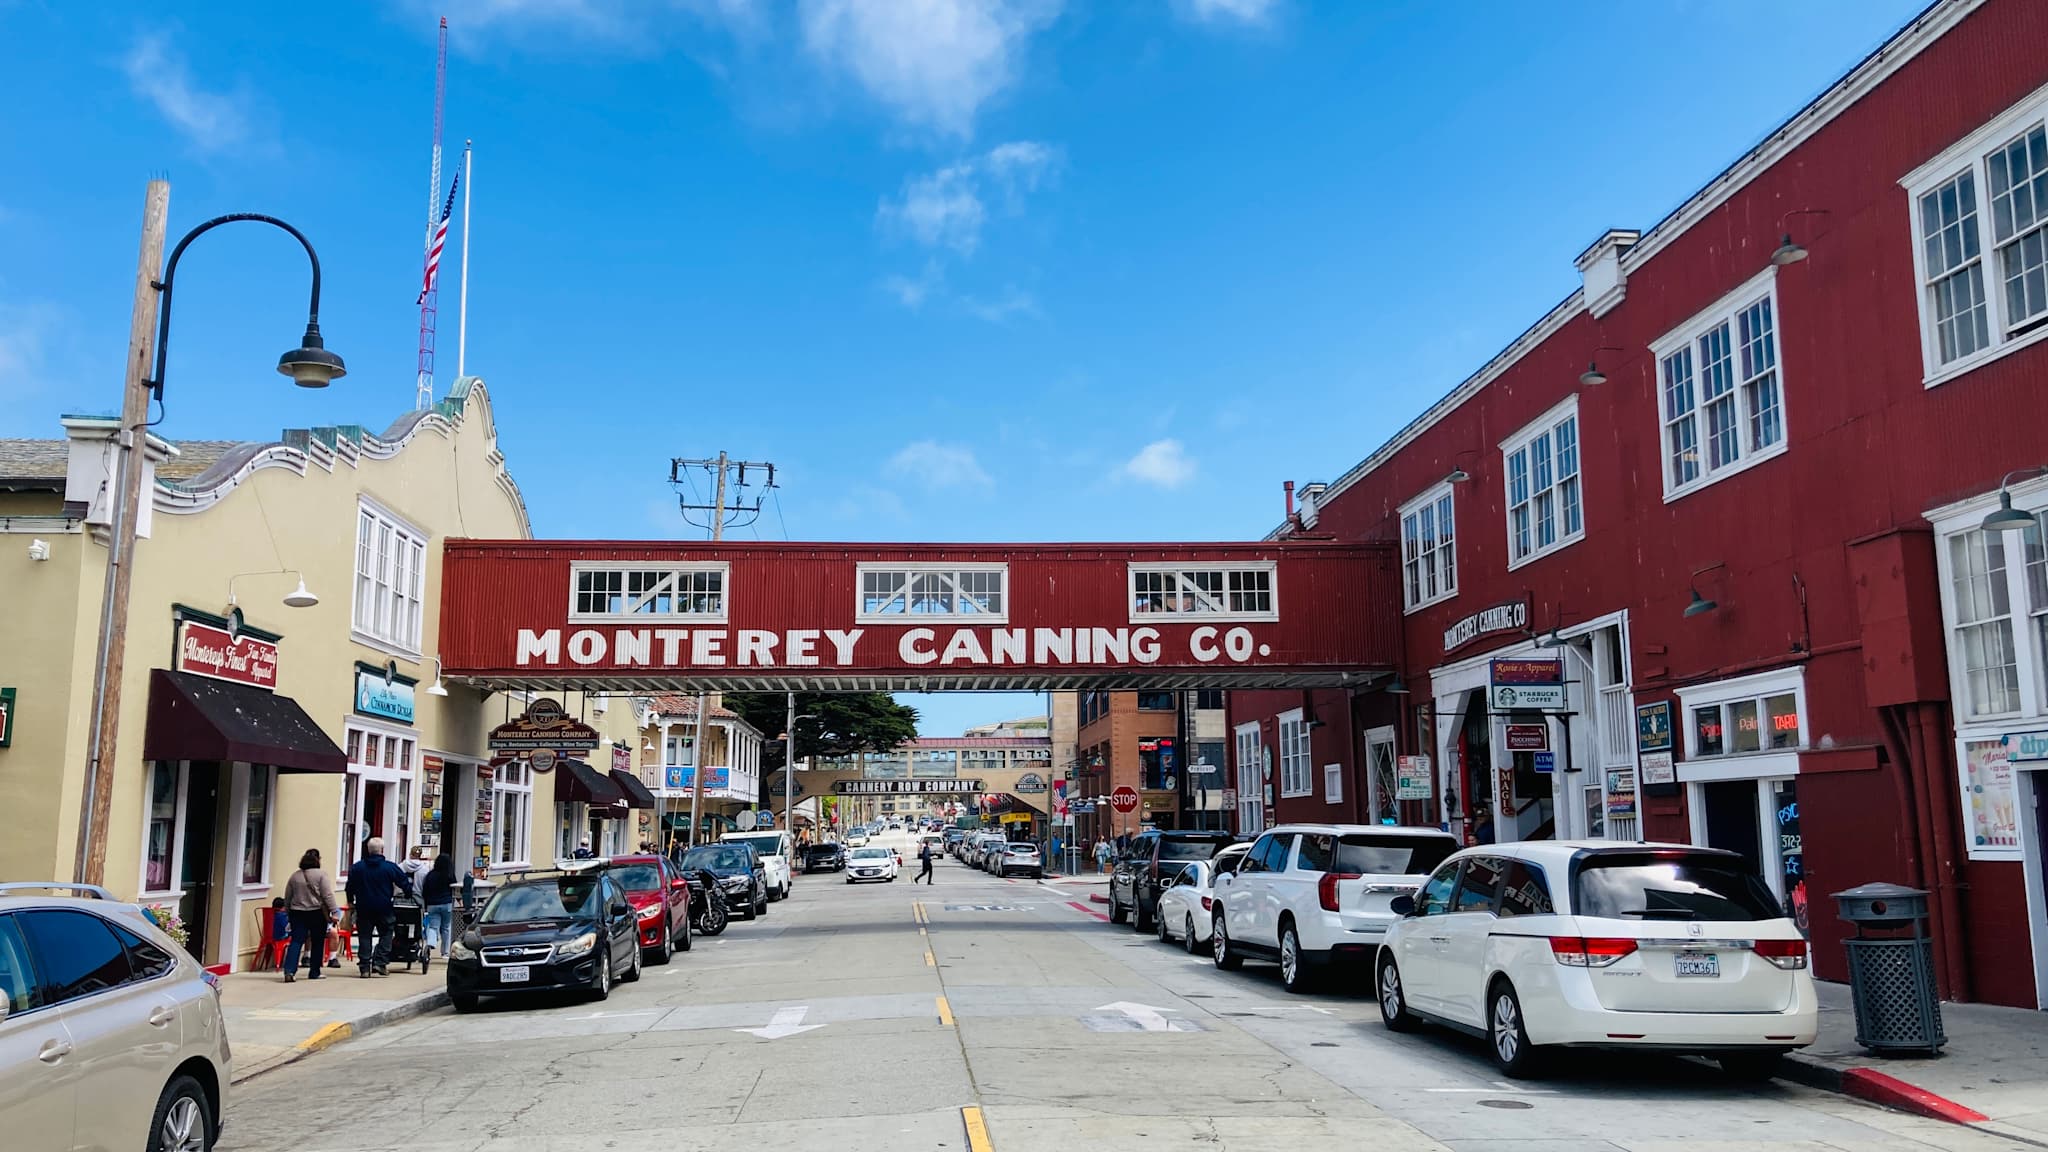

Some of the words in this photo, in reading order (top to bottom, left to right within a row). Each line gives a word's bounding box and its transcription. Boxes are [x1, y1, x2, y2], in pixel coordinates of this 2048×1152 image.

[1444, 614, 1478, 651] MONTEREY
[1479, 605, 1512, 633] CANNING
[1513, 603, 1525, 627] CO
[259, 646, 277, 669] Family
[515, 629, 864, 666] MONTEREY
[898, 627, 1161, 665] CANNING
[1189, 626, 1271, 663] CO.
[225, 645, 248, 671] Finest
[1495, 663, 1523, 673] Rosie's
[1524, 663, 1556, 674] Apparel
[251, 662, 273, 682] Apparel
[846, 781, 893, 792] CANNERY
[898, 781, 921, 792] ROW
[925, 781, 975, 792] COMPANY
[1501, 771, 1511, 815] MAGIC
[1113, 794, 1137, 806] STOP
